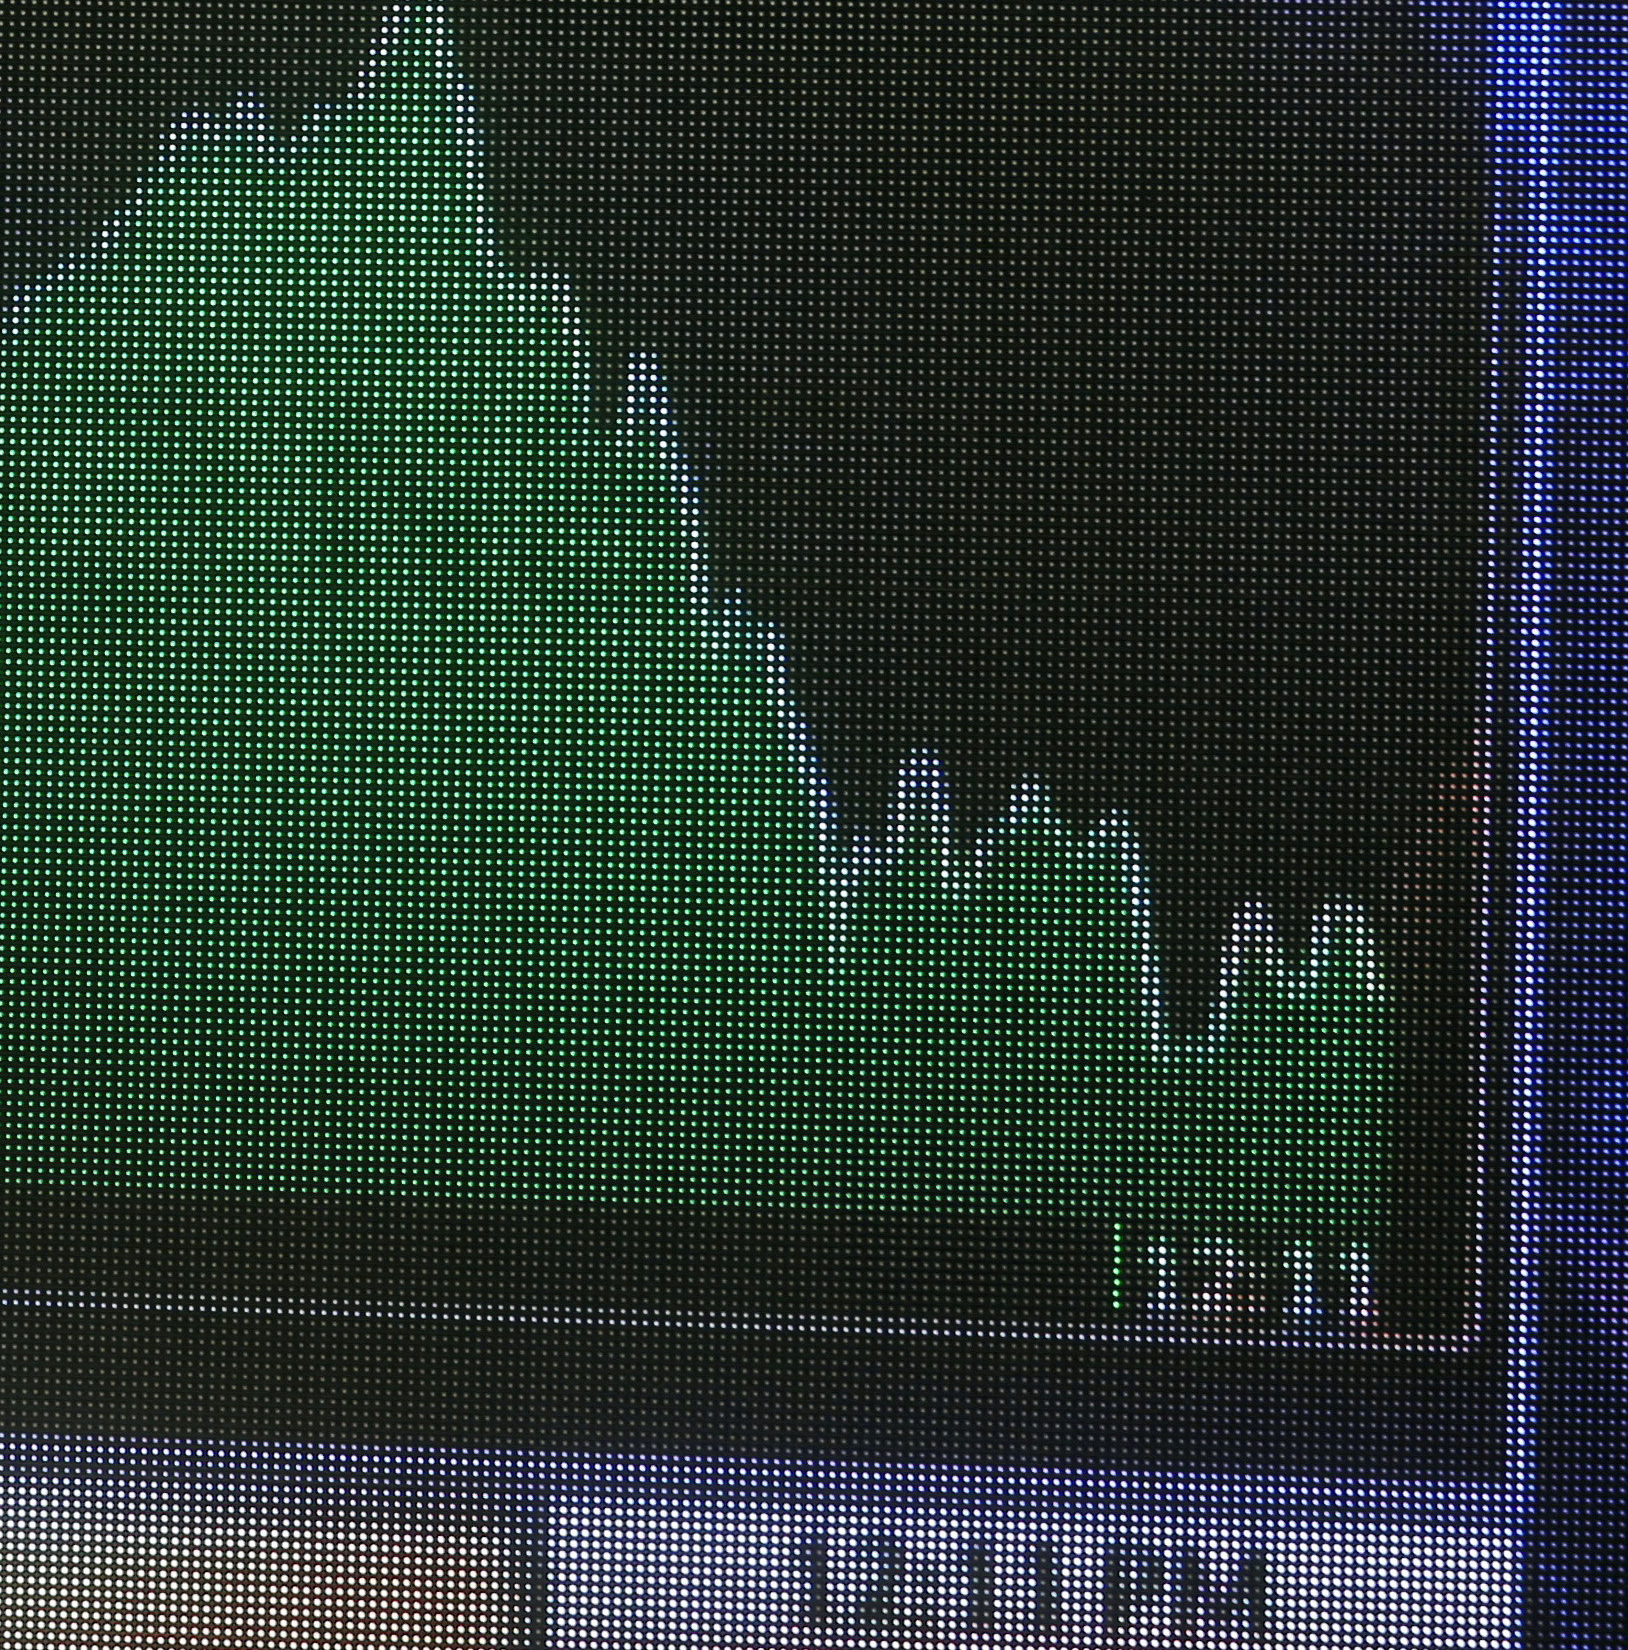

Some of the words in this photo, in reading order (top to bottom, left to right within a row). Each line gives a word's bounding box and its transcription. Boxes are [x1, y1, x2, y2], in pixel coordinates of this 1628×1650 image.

[1143, 1235, 1382, 1325] 12:11
[791, 1528, 1063, 1635] 12:11
[1103, 1536, 1271, 1642] PM
